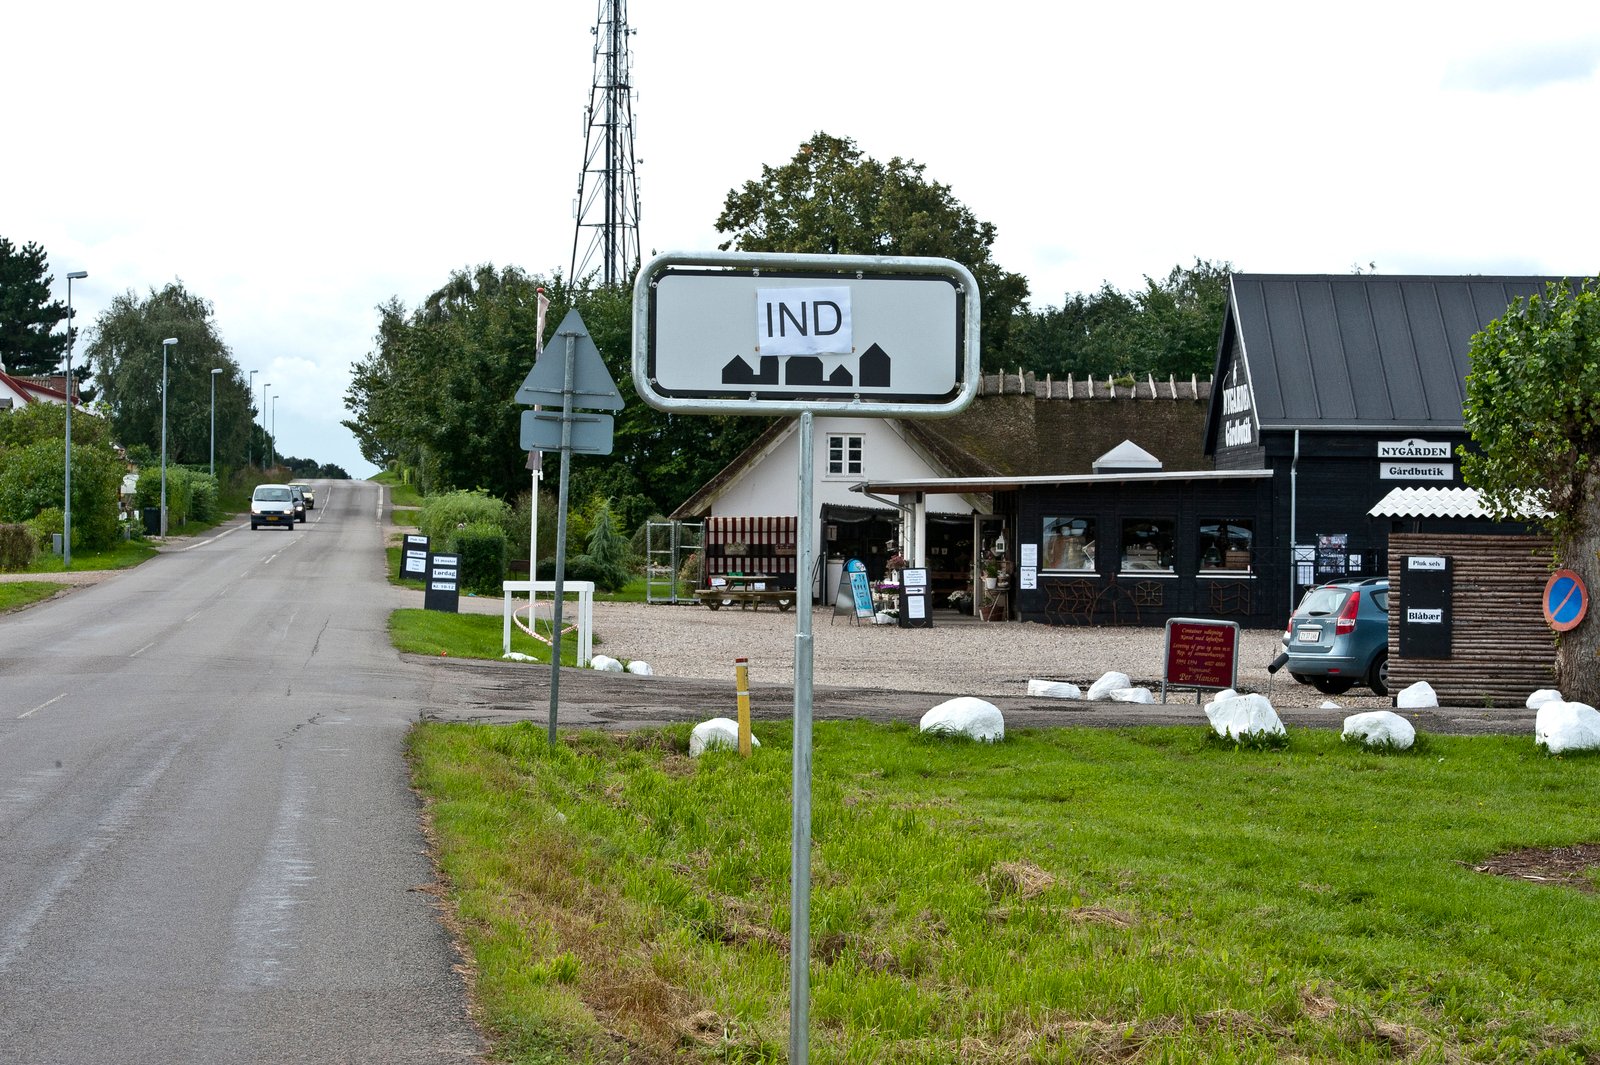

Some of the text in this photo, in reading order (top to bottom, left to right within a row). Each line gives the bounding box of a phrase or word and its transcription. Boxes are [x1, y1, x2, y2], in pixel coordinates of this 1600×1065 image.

[766, 300, 842, 338] IND
[1389, 466, 1444, 476] Gårdbutik
[1409, 612, 1440, 620] Blåbær
[1195, 673, 1219, 682] Hansen
